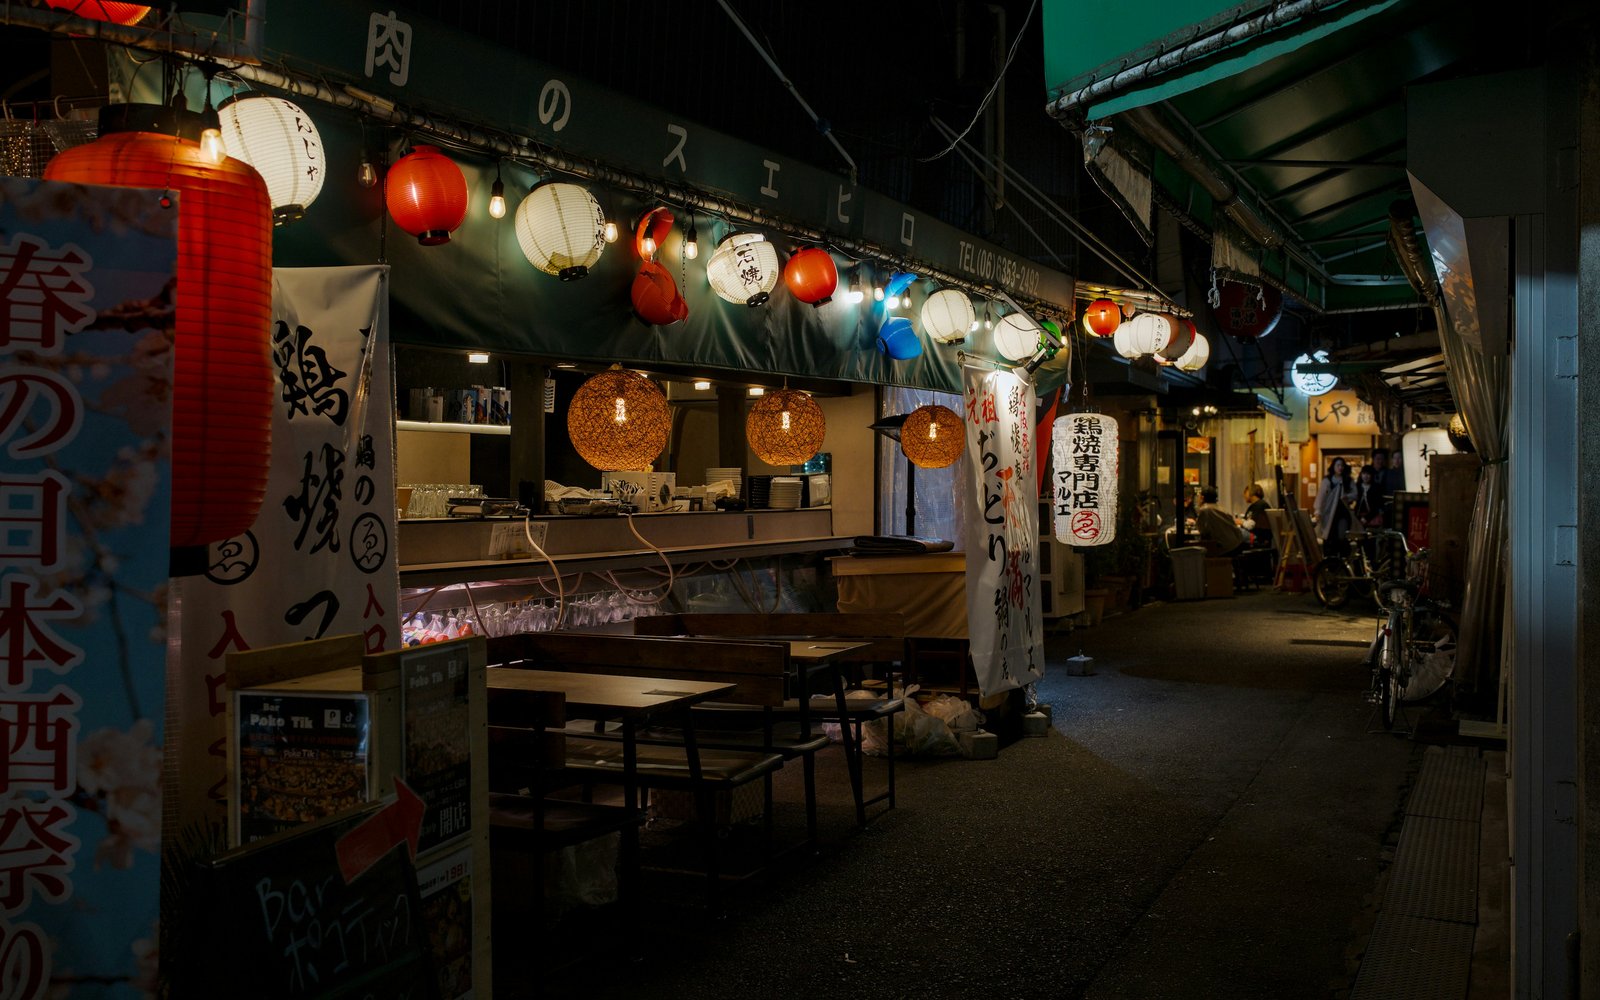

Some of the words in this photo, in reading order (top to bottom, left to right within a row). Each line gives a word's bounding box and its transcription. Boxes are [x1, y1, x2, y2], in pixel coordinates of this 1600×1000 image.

[366, 10, 915, 248] 肉のスエヒロ
[1072, 415, 1103, 510] 鶏焼専門店
[1057, 470, 1073, 516] マルエ
[250, 713, 286, 728] Poko
[290, 715, 314, 730] Tik
[262, 702, 281, 712] Bar
[256, 874, 335, 944] Bar
